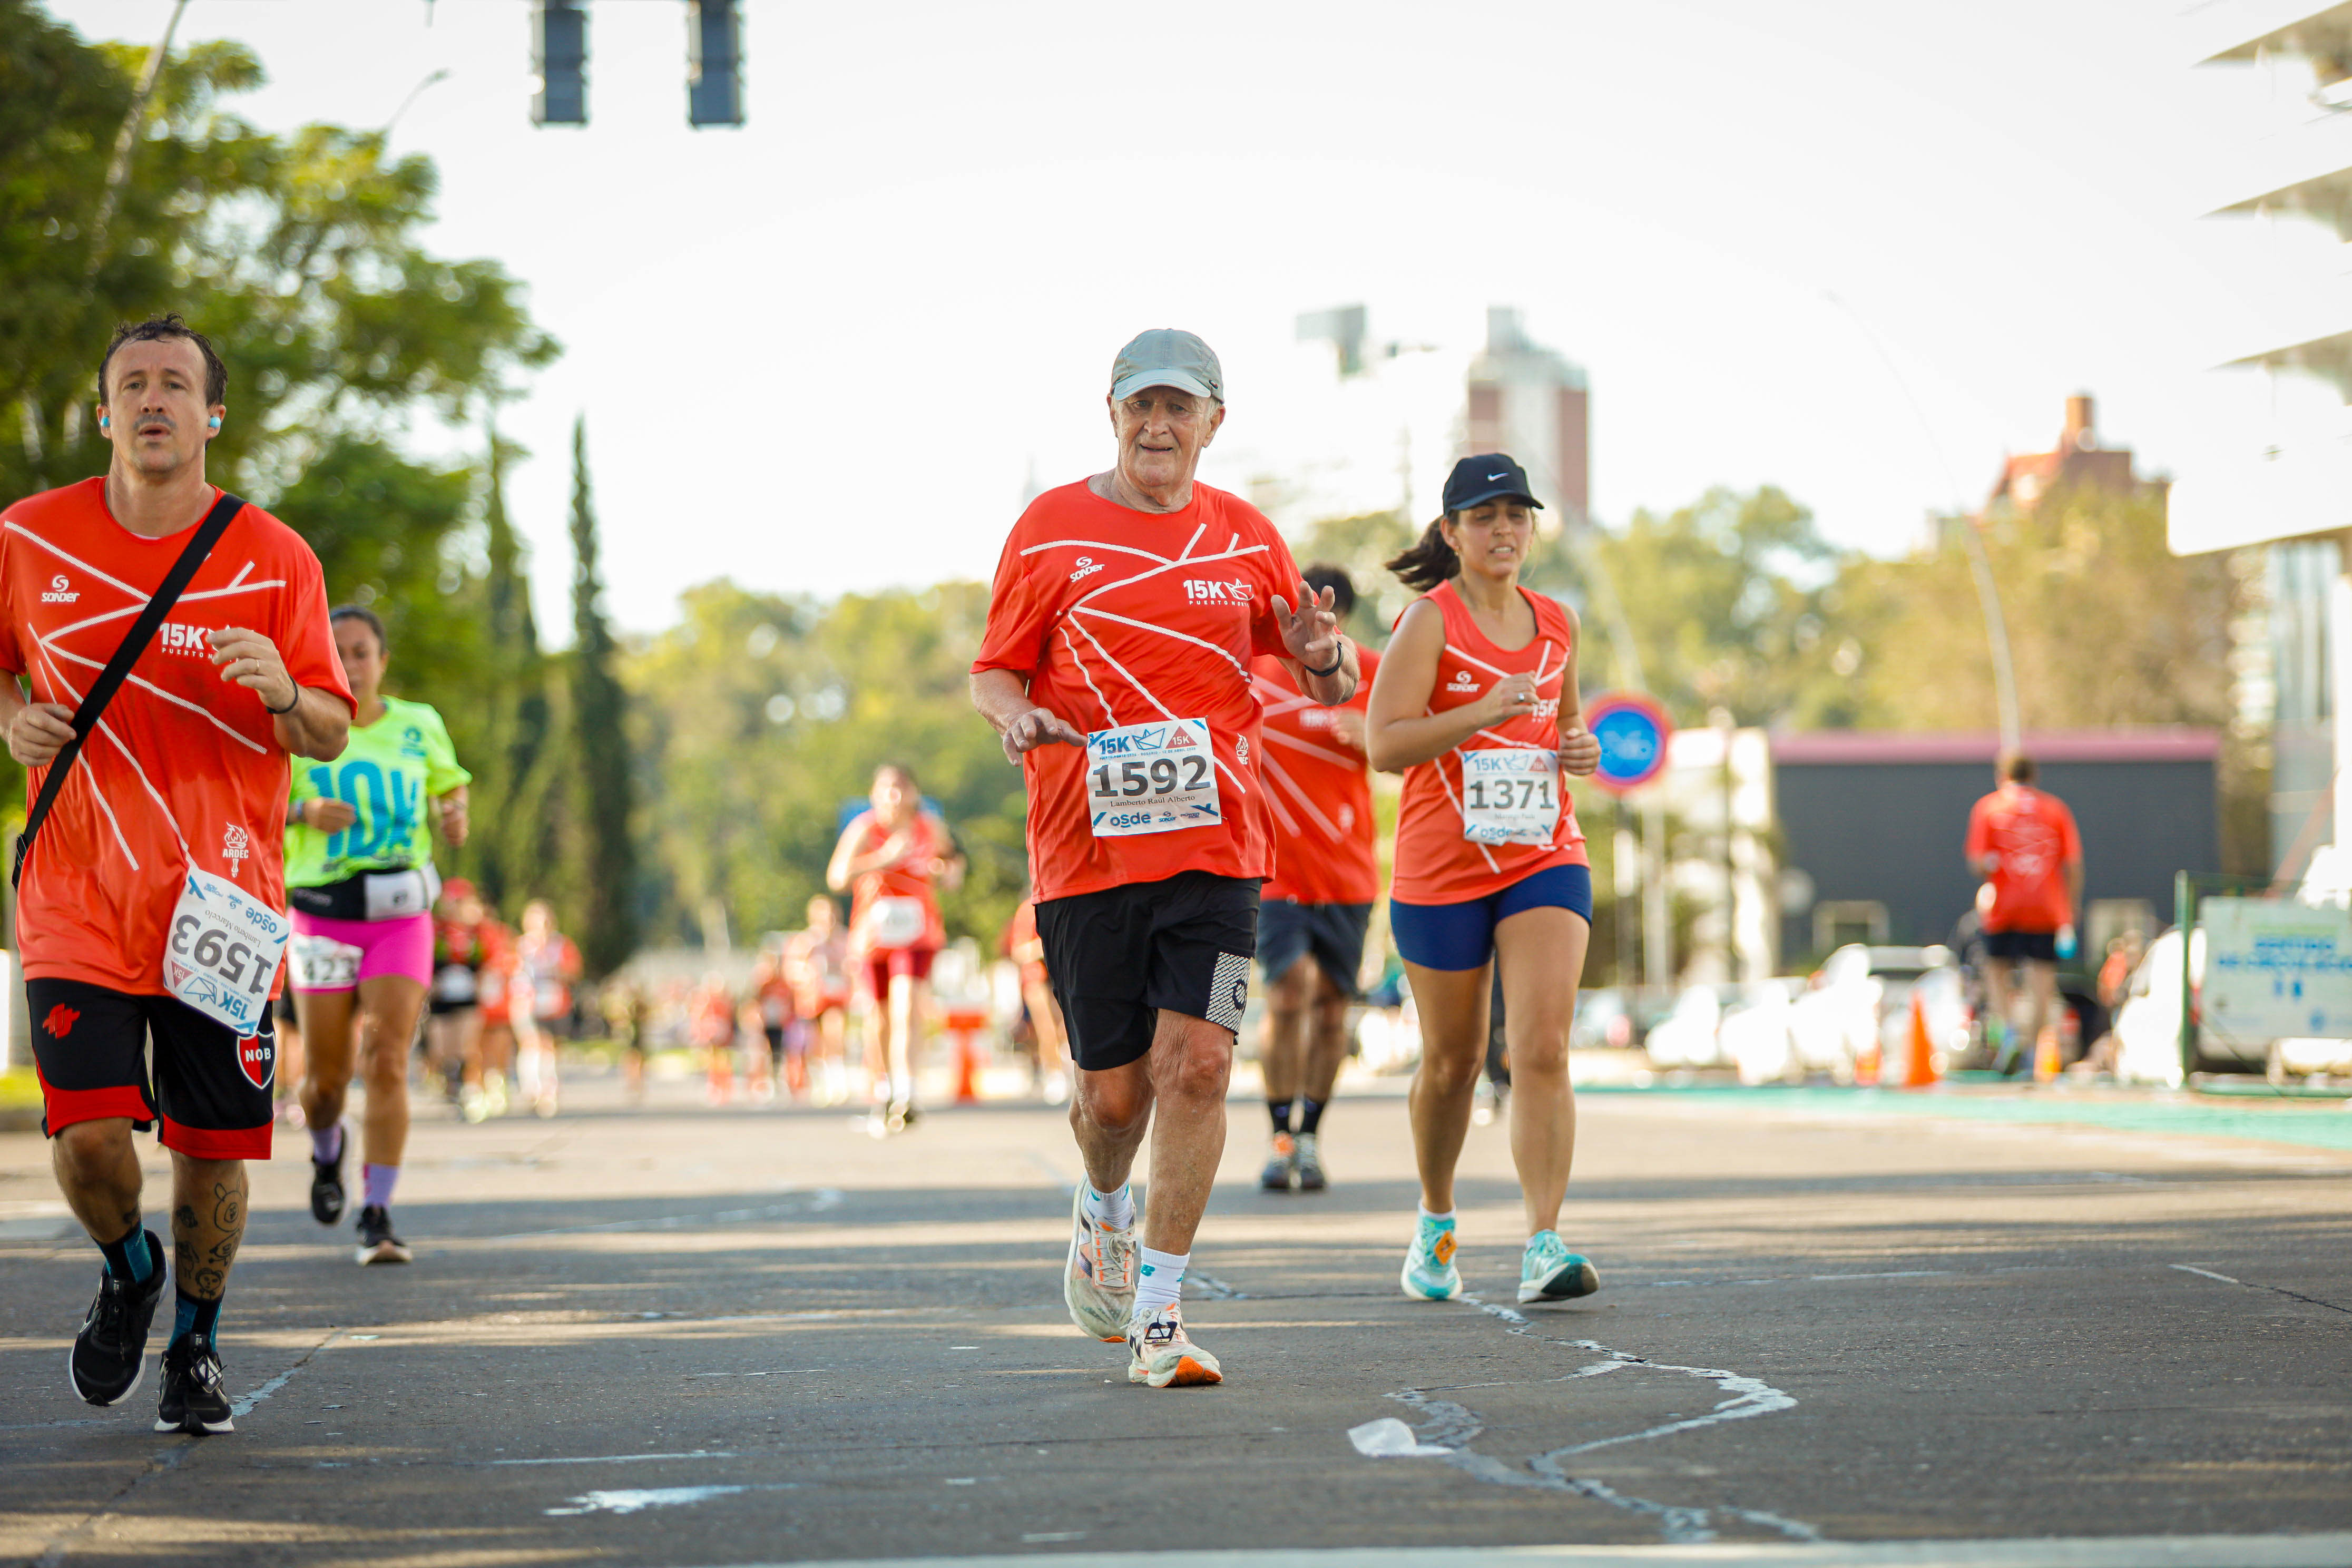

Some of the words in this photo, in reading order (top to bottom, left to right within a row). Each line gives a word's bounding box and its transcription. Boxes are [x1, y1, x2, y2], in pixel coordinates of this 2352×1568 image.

[1183, 580, 1227, 599] 15K
[160, 623, 206, 650] 15K
[162, 648, 204, 658] PUERTO
[1100, 736, 1130, 754] 15K
[1172, 735, 1190, 745] 15K
[1474, 758, 1502, 771] 15K
[1093, 755, 1211, 797] 1592
[1470, 779, 1554, 809] 1371
[1110, 812, 1151, 828] osde
[223, 849, 249, 858] ARDEC
[205, 909, 234, 930] Marcelo
[246, 907, 277, 934] osde
[234, 925, 261, 948] Lamberto
[172, 914, 273, 994] 1593
[174, 966, 184, 979] 15K
[218, 991, 248, 1020] 15K
[245, 1047, 271, 1062] NOB
